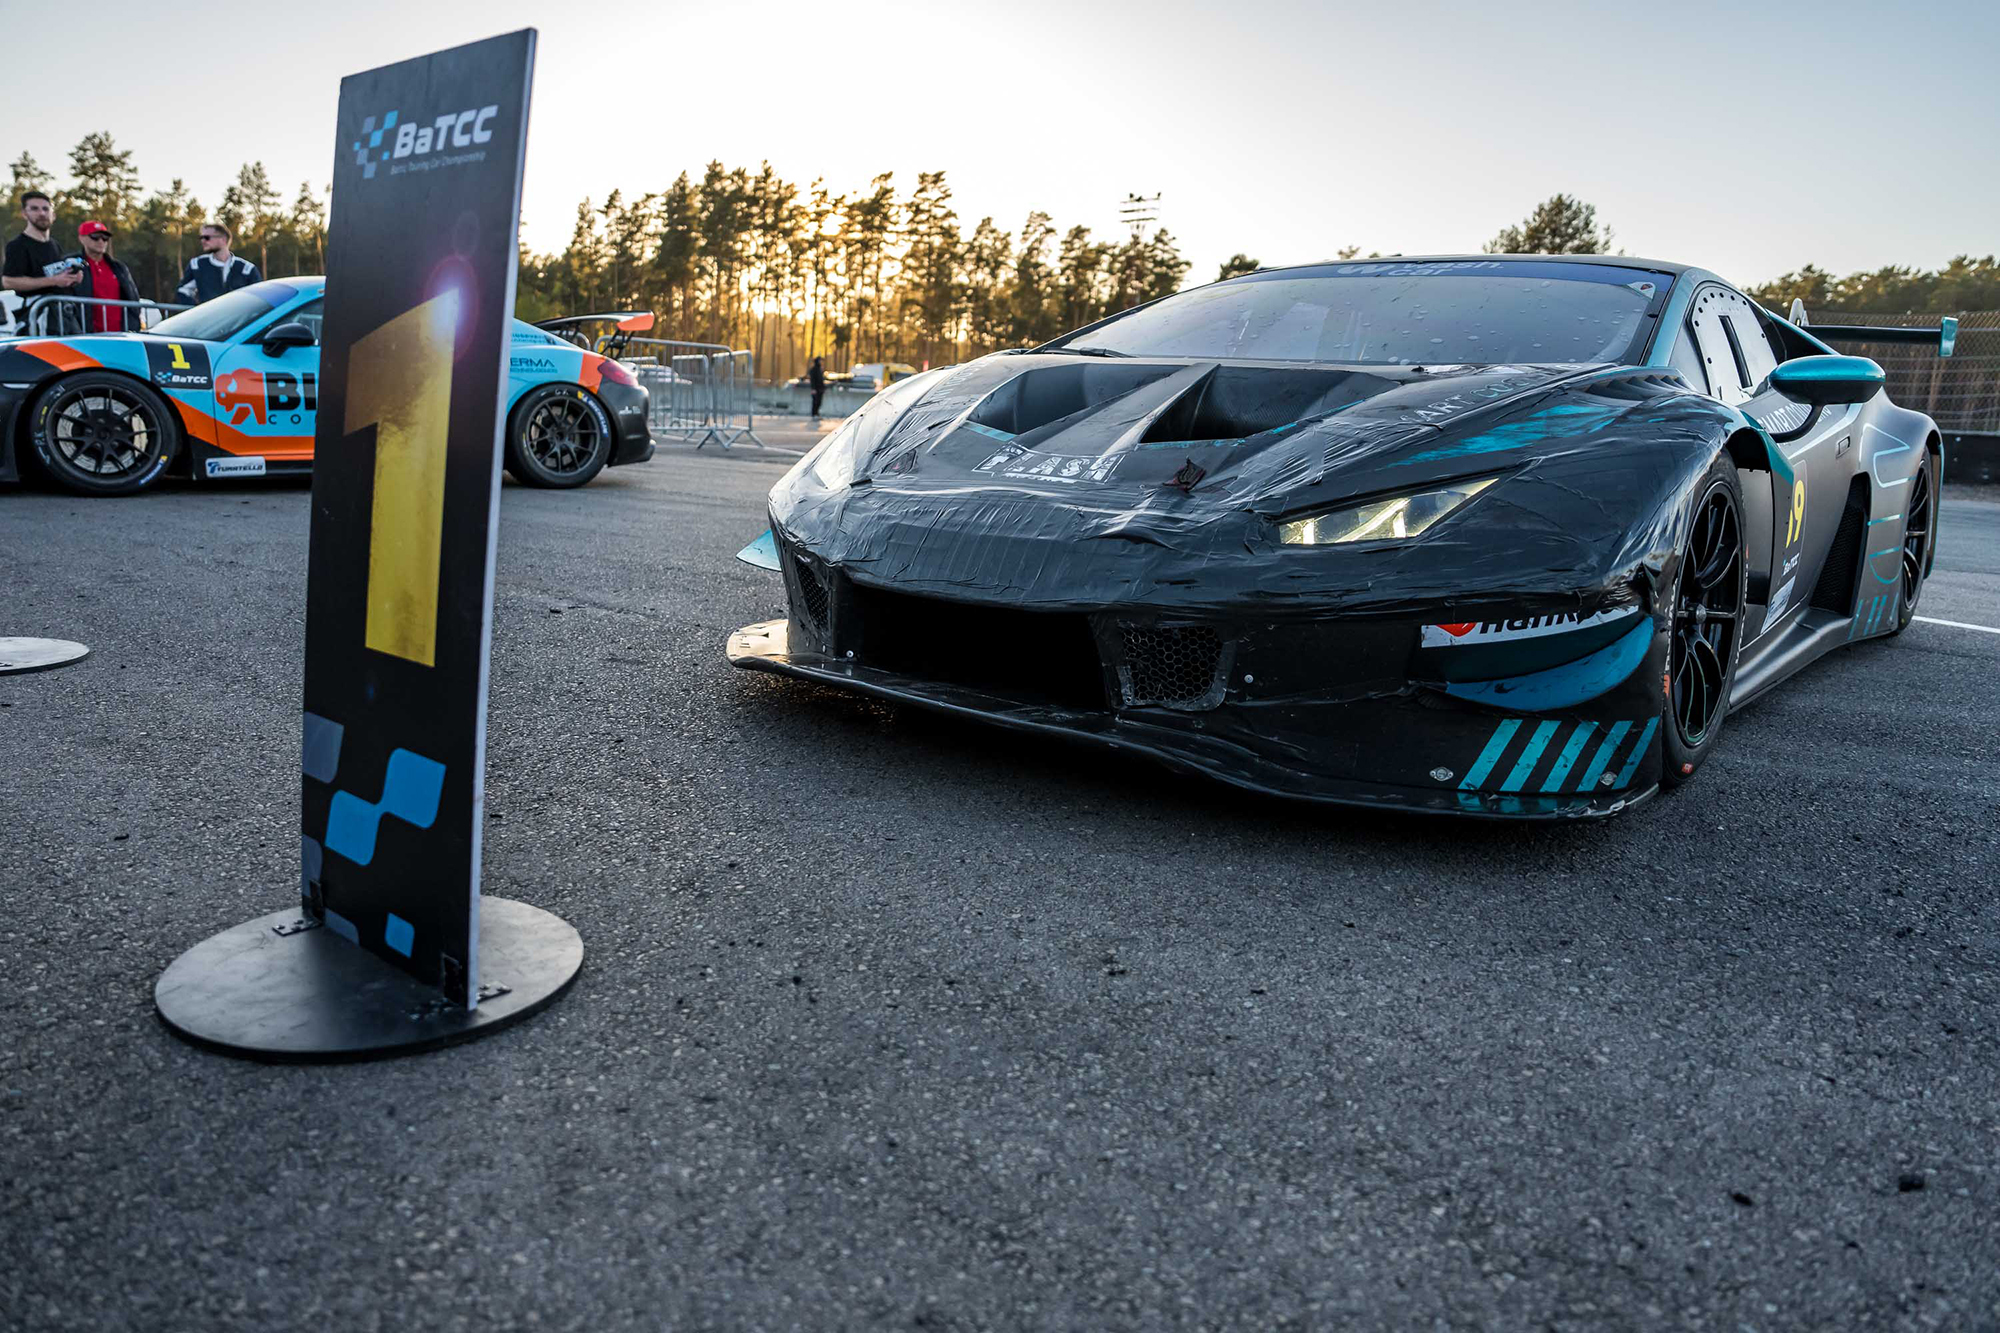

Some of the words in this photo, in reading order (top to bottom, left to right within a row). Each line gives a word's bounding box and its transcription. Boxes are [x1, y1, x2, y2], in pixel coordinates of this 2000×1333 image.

[393, 105, 498, 158] BaTCC
[168, 344, 190, 369] 1
[171, 375, 208, 384] BaTCC
[268, 414, 317, 425] CO
[343, 287, 460, 667] 1
